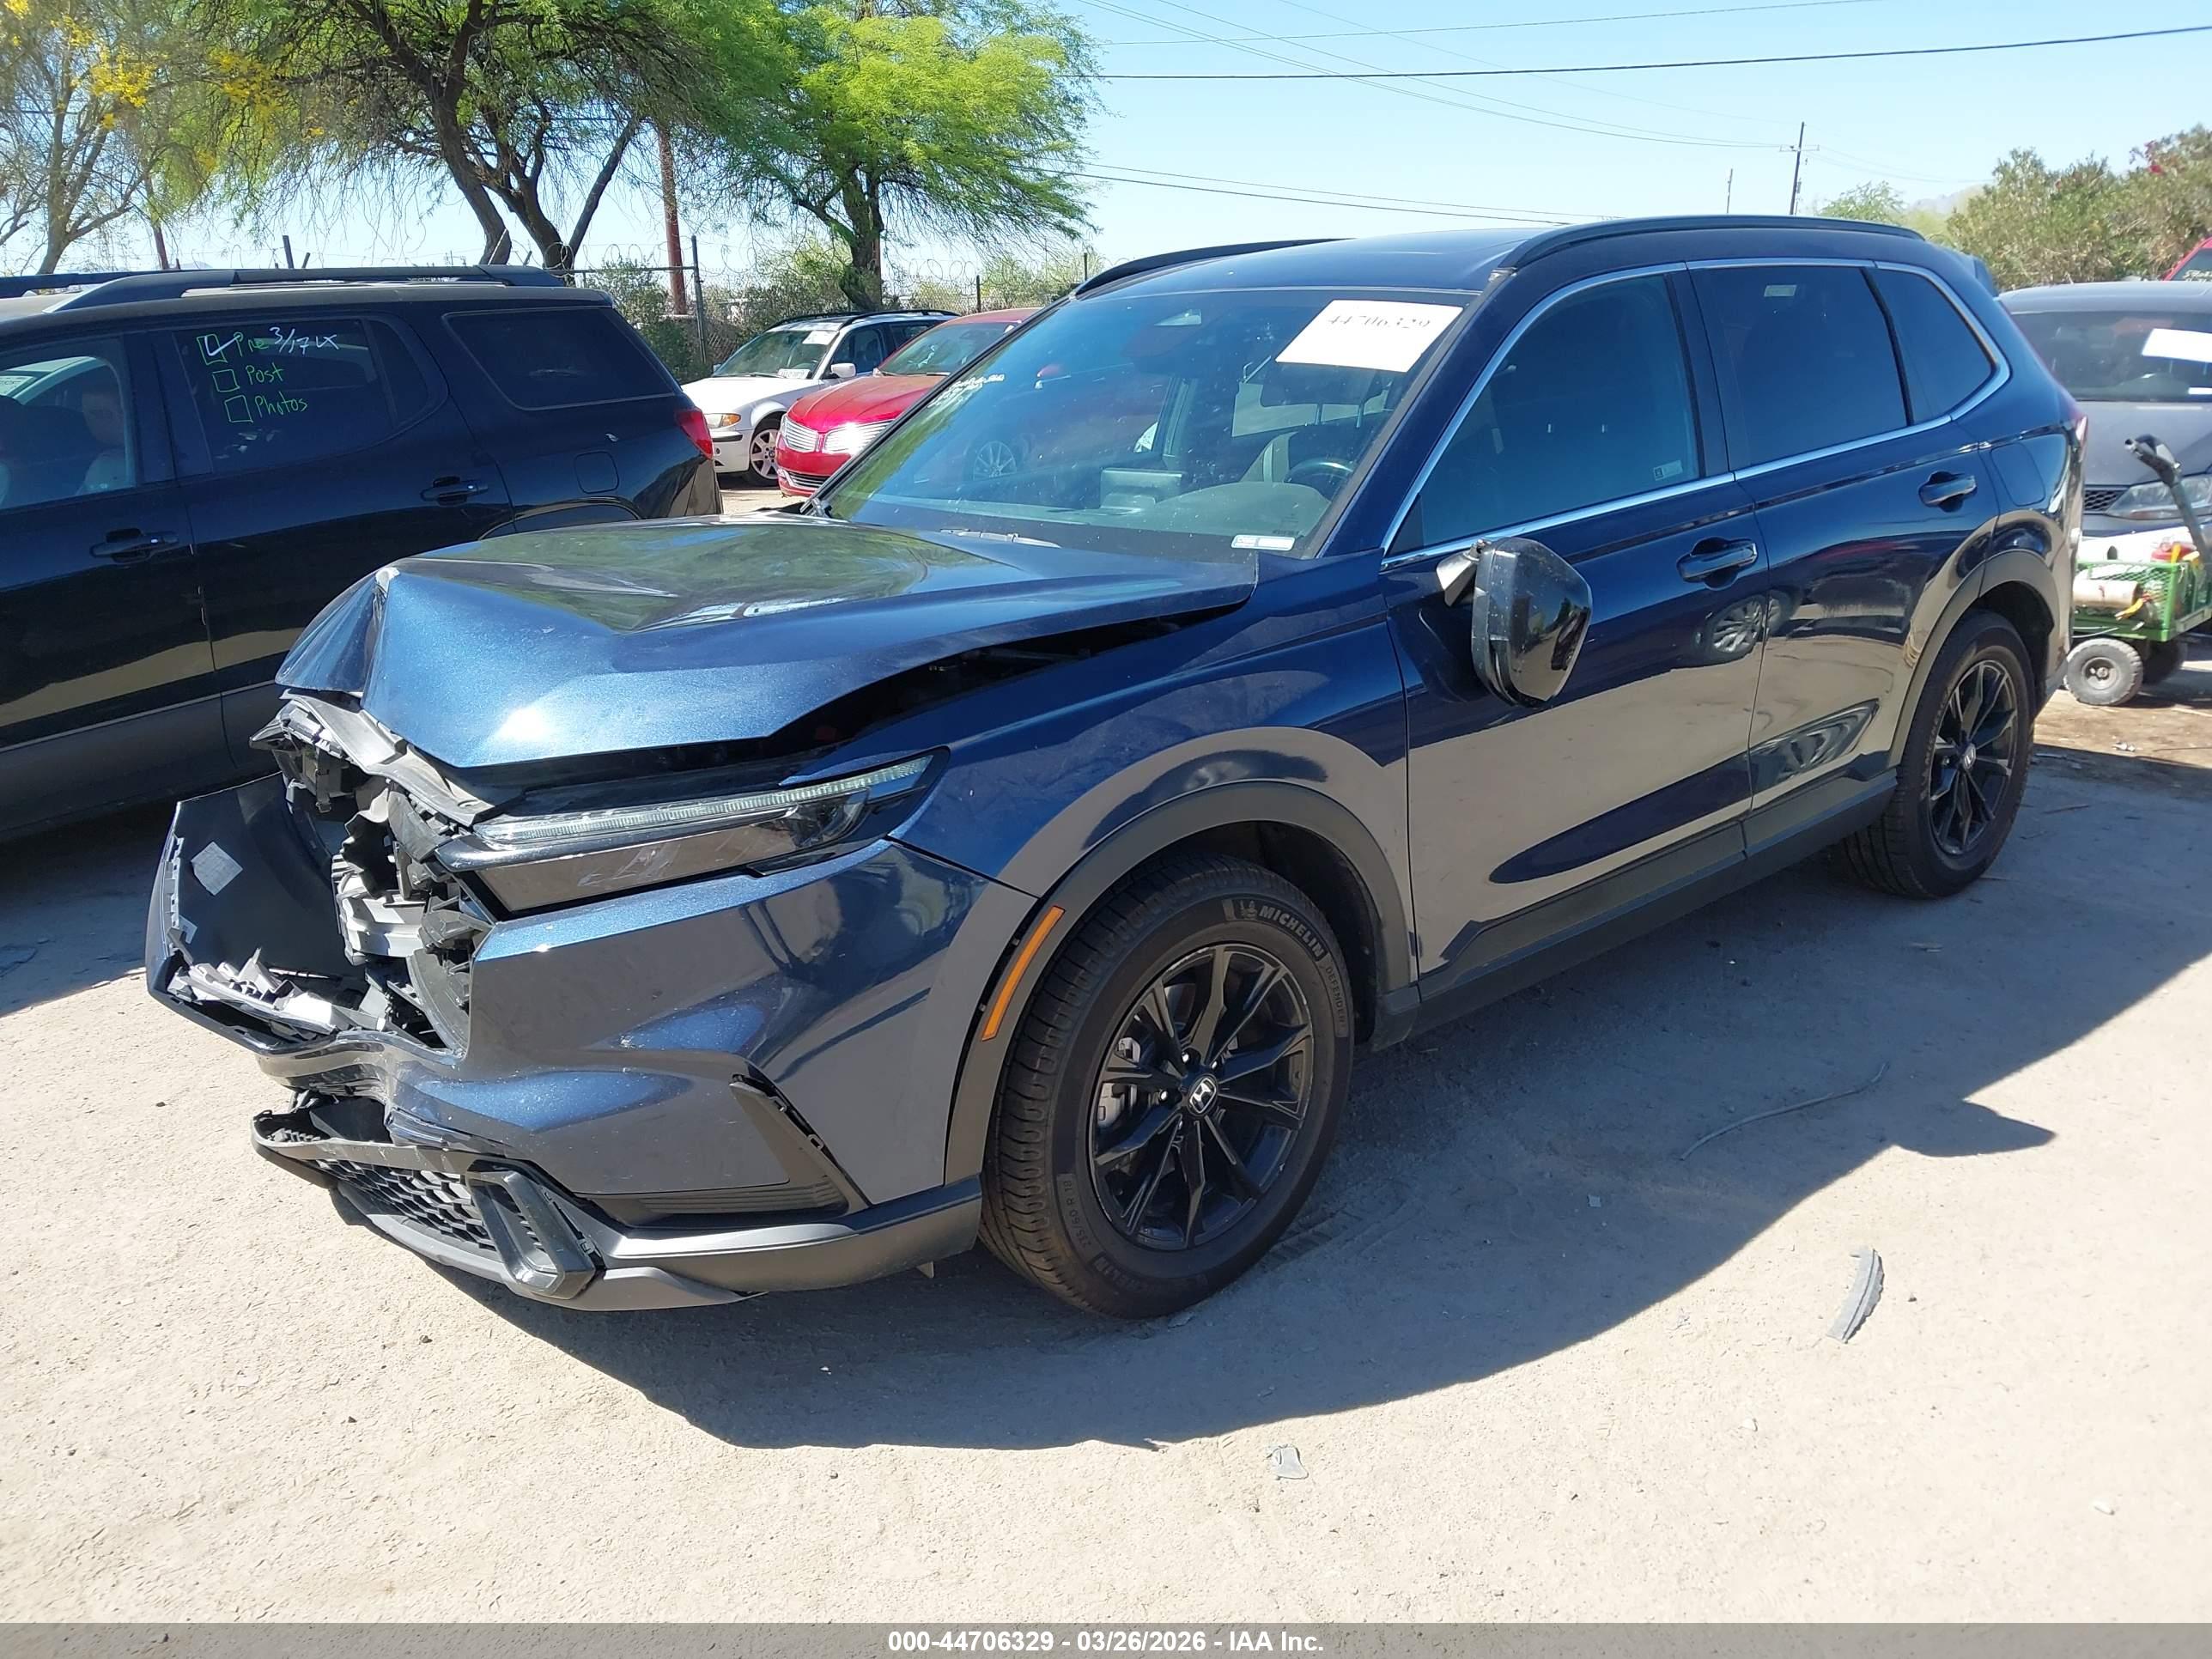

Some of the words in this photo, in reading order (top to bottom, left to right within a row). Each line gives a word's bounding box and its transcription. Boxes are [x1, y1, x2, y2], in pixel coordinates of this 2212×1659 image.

[234, 331, 269, 357] Pre
[270, 326, 309, 355] 3/17
[246, 363, 284, 385] Post
[254, 391, 308, 418] Photos
[1259, 905, 1325, 958] MICHELIN
